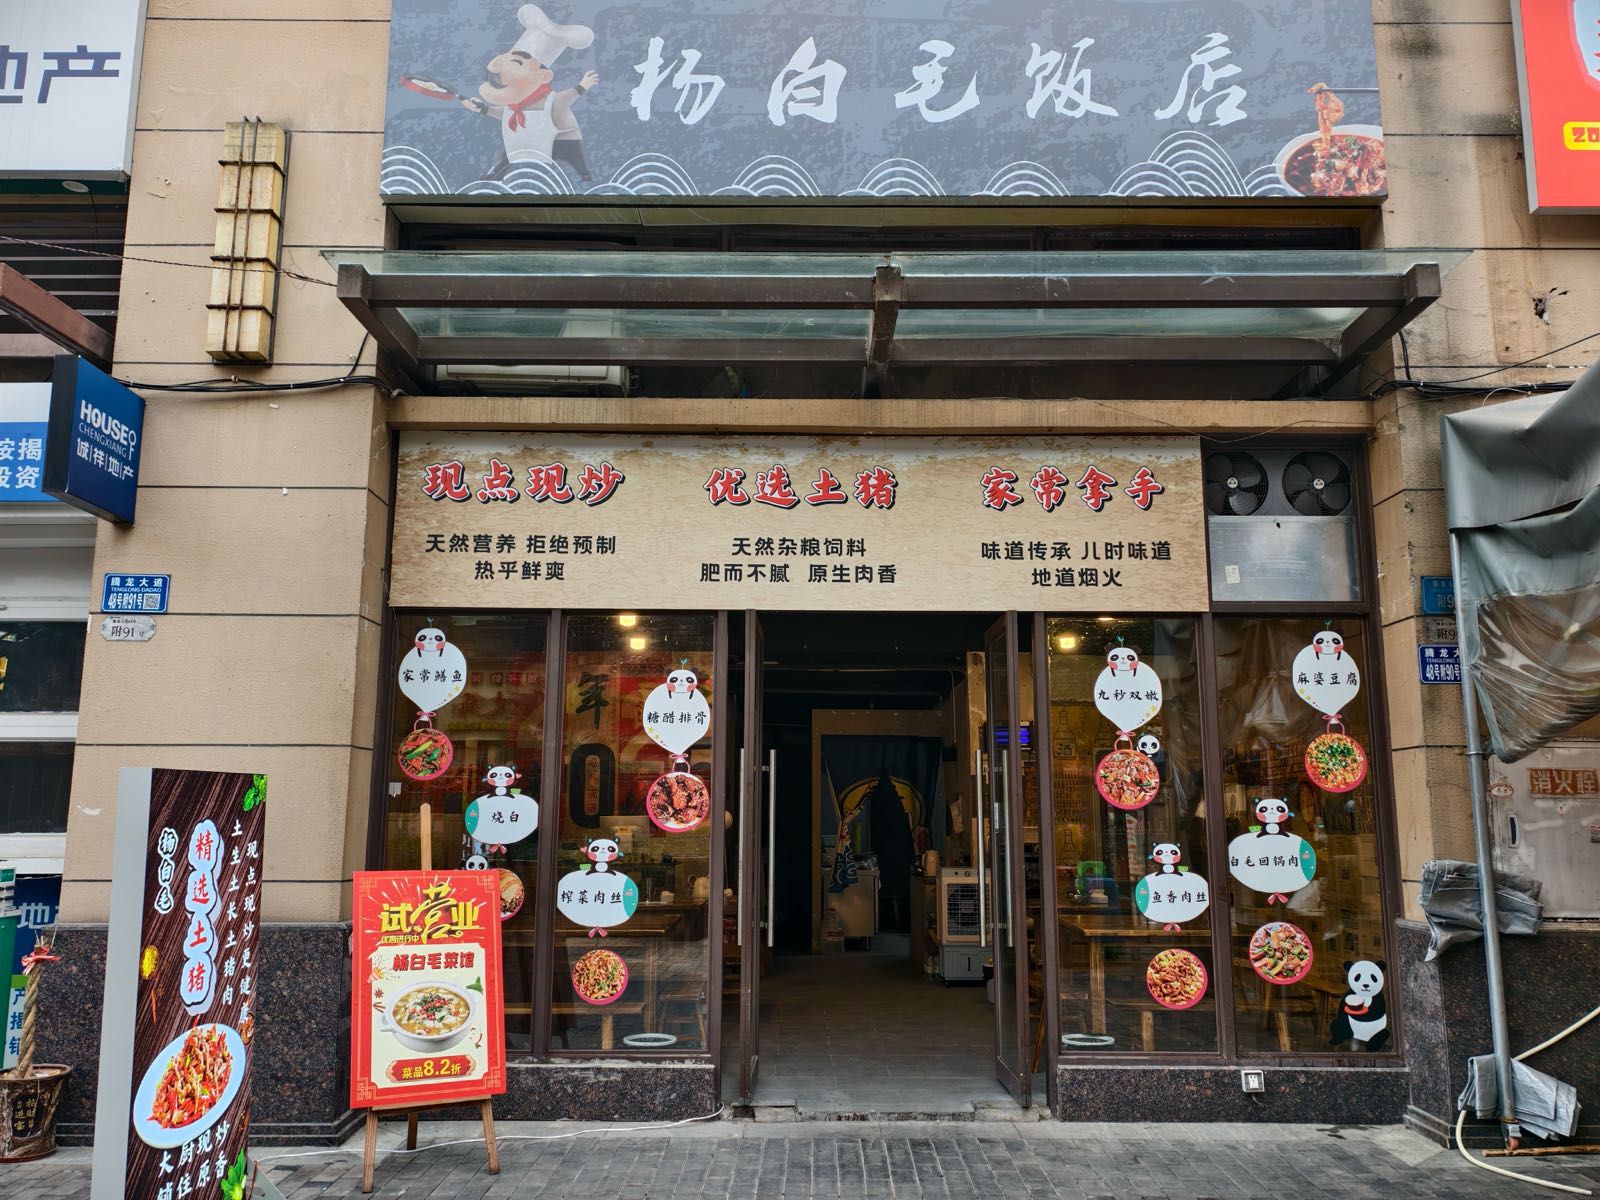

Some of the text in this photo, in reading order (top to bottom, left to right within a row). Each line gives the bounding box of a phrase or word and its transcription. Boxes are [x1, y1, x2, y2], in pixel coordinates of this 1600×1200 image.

[630, 32, 1248, 126] 杨白毛饭店
[81, 399, 128, 445] HOUSE
[79, 422, 127, 458] CHENGXIANG
[423, 459, 1167, 513] 现点现炒 优选土猪 家常拿手
[425, 533, 617, 555] 天然营养 拒绝预制
[731, 537, 867, 557] 天然杂粮饲料
[981, 541, 1172, 561] 味道传承 儿时味道
[474, 560, 566, 581] 热乎鲜爽
[699, 563, 898, 585] 肥而不腻 原生肉香
[1031, 567, 1124, 588] 地道烟火
[110, 576, 163, 587] 腾龙大道
[107, 593, 143, 609] 48号附91号
[402, 668, 463, 683] 家常鳝鱼
[1297, 672, 1360, 686] 麻婆豆腐
[646, 711, 707, 725] 糖醋排骨
[1532, 770, 1596, 794] 消火栓
[491, 810, 519, 824] 烧白
[156, 829, 178, 913] 杨白毛
[1230, 855, 1299, 868] 白毛回锅肉
[561, 889, 622, 904] 榨菜肉丝
[1152, 890, 1208, 903] 鱼香肉丝
[187, 829, 214, 993] 精选土猪
[222, 819, 242, 1005] 土生土长土猪肉
[380, 881, 480, 944] 试营业
[392, 951, 475, 972] 杨白毛菜馆
[402, 1058, 461, 1079] 菜品8.2折
